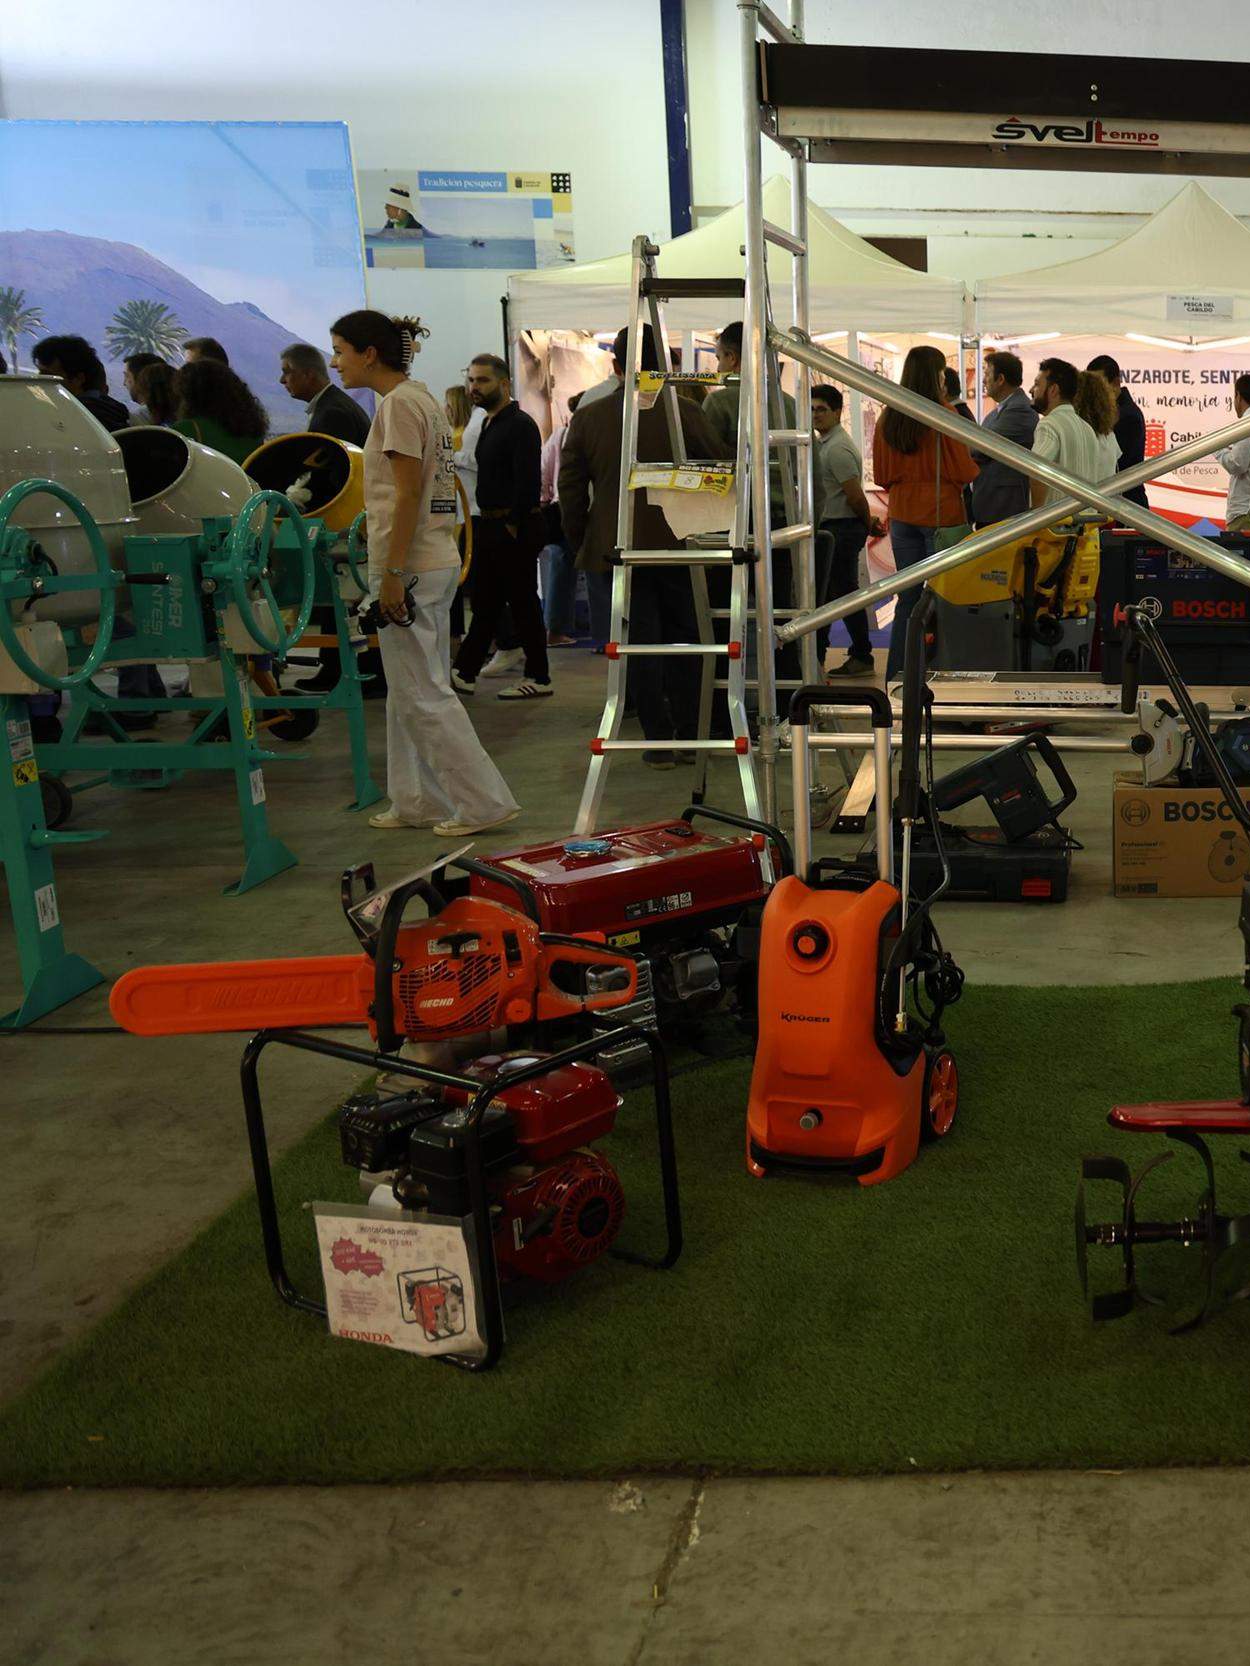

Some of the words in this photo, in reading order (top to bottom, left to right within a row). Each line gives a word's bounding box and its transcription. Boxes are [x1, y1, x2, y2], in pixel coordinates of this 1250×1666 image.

[1120, 369, 1195, 386] NZAROTE,
[1156, 393, 1220, 412] memoria
[1180, 467, 1192, 476] de
[1194, 467, 1219, 478] Pesca
[151, 561, 166, 640] SNTESI
[1170, 600, 1246, 618] BOSCH
[338, 1329, 394, 1344] HONDA
